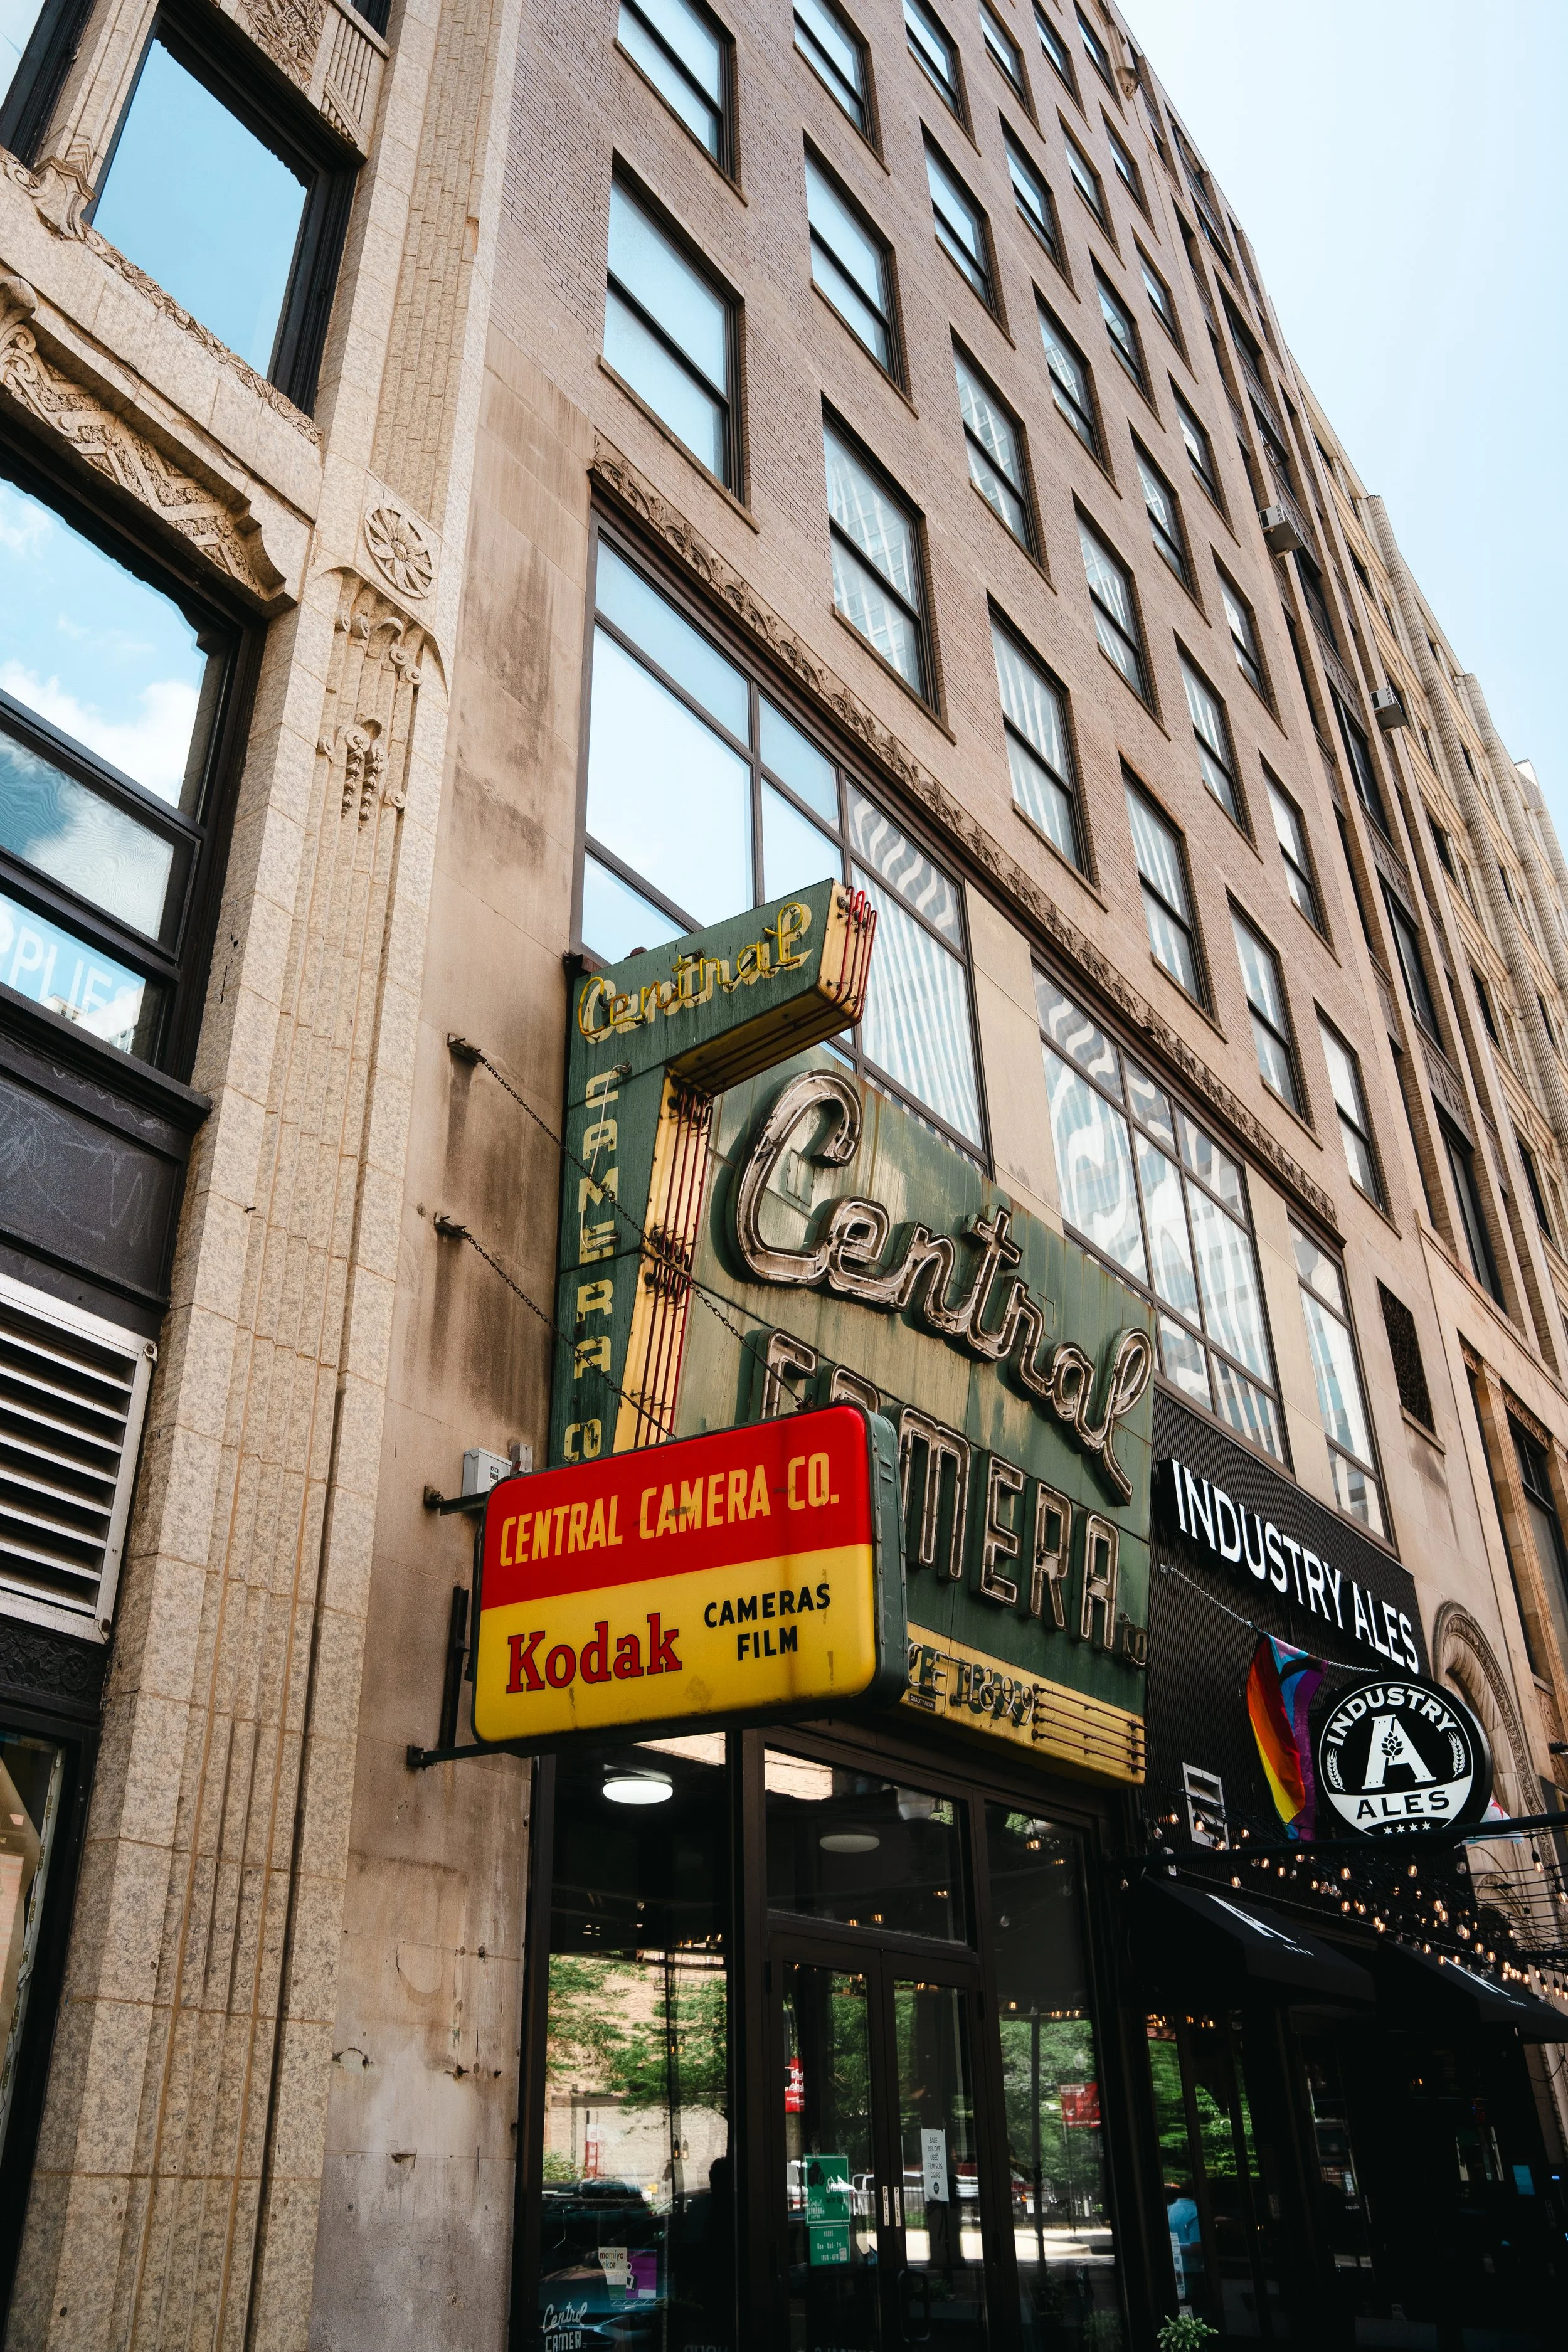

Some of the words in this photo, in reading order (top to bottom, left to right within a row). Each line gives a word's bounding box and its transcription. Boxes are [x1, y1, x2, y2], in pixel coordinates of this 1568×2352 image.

[578, 901, 813, 1045] Central
[573, 1071, 619, 1379] CAMERA
[733, 1069, 1154, 1507] Central
[499, 1495, 623, 1567] CENTRAL
[639, 1464, 771, 1540] CAMERA
[787, 1451, 840, 1511] CO.
[1171, 1457, 1343, 1629] INDUSTRY
[1352, 1580, 1420, 1675] ALES
[704, 1582, 831, 1628] CAMERAS
[506, 1612, 683, 1695] Kodak
[737, 1625, 799, 1661] FILM
[910, 1695, 924, 1705] QUALITY
[956, 1658, 1037, 1729] 1899
[1327, 1687, 1457, 1746] INDUSTRY
[1356, 1789, 1451, 1820] ALES
[600, 2250, 624, 2260] mamiya
[601, 2260, 616, 2269] ekor
[542, 2301, 588, 2334] Central
